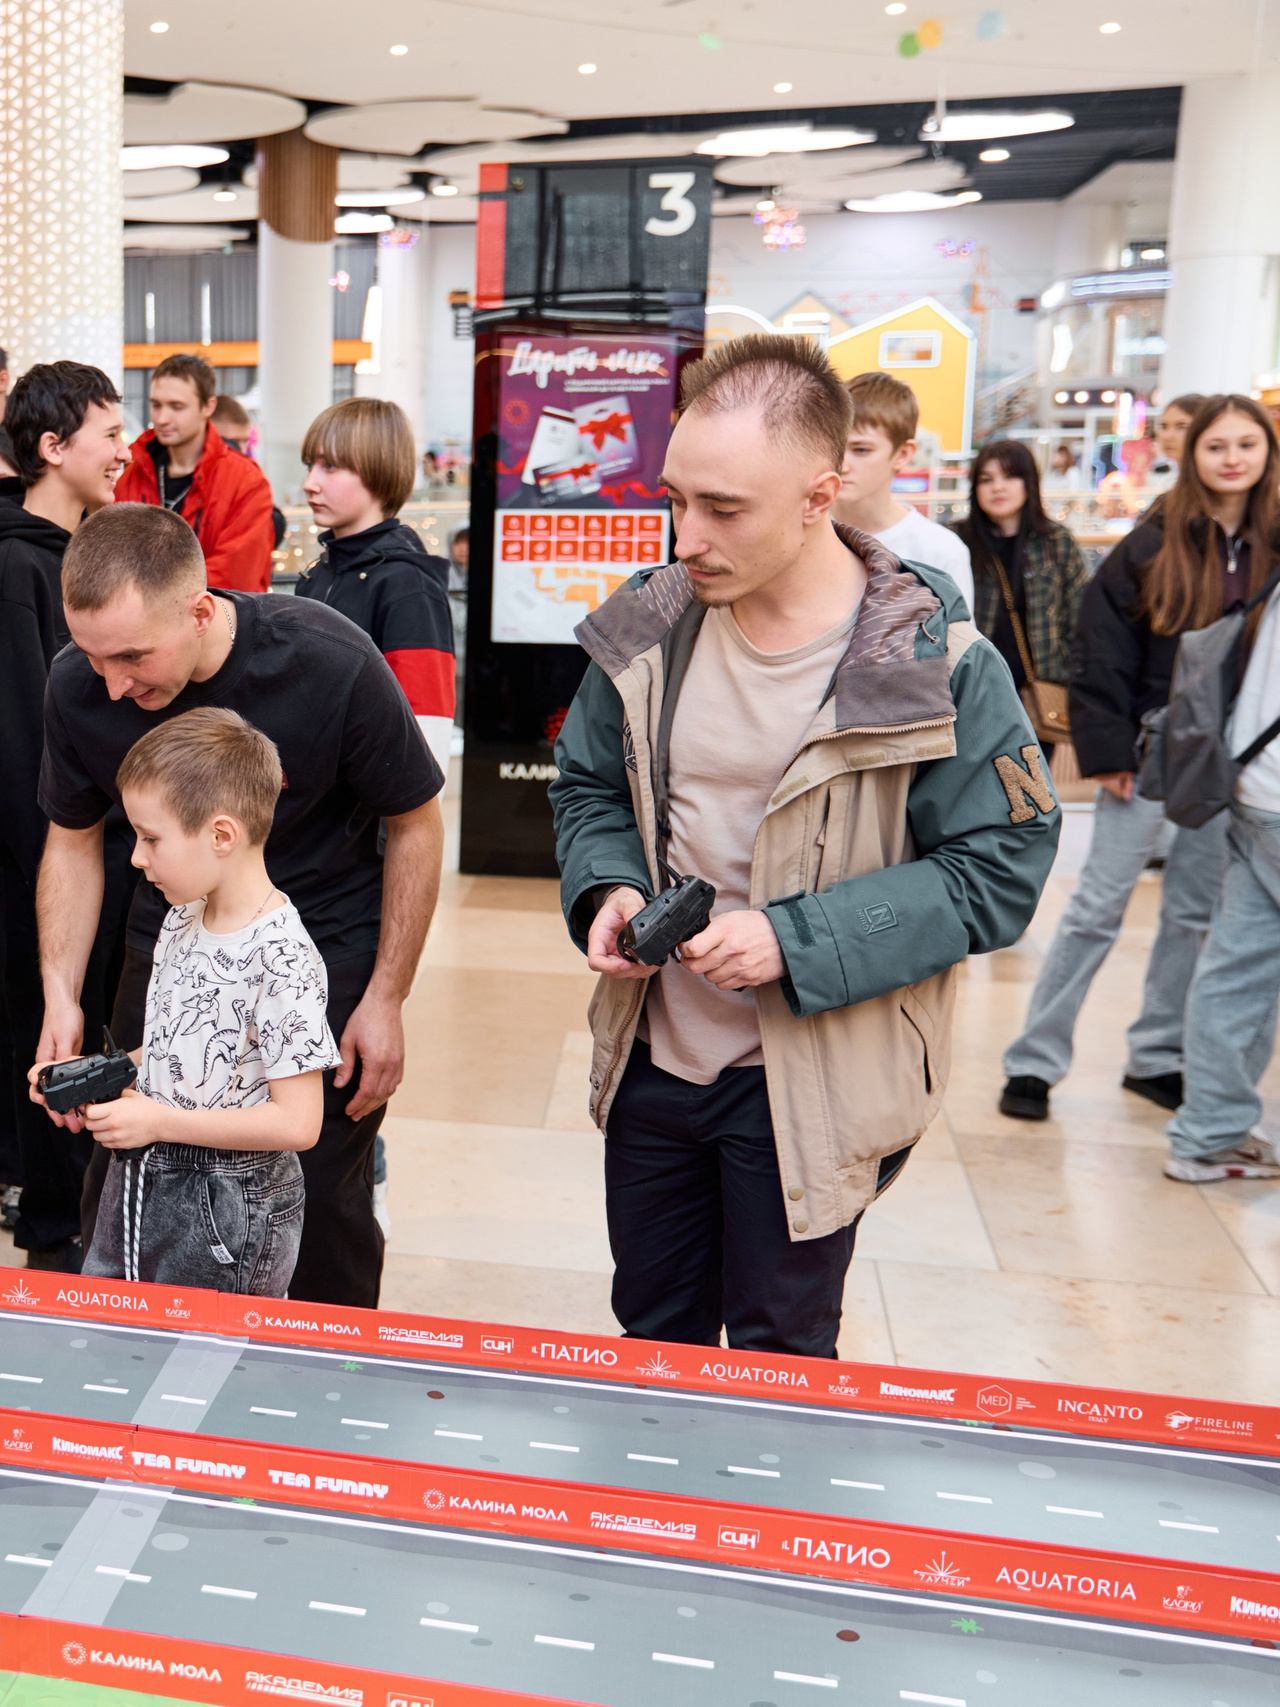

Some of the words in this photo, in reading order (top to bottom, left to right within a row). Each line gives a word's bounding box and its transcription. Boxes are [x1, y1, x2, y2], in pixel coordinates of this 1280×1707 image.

[644, 172, 697, 237] 3
[992, 744, 1057, 825] N
[56, 1289, 149, 1312] AQUATORIA
[265, 1316, 319, 1331] КАЛИНА
[379, 1326, 463, 1343] АКАДЕМИЯ
[540, 1343, 618, 1366] ПАТИО
[700, 1362, 809, 1388] AQUATORIA
[880, 1382, 955, 1402] КИНОМАКС
[980, 1394, 1008, 1407] MED
[1057, 1399, 1143, 1421] INCANTO
[1194, 1417, 1254, 1431] FIRELINE
[52, 1437, 123, 1460] КИНОМАКС
[132, 1451, 170, 1469] TEA
[175, 1457, 246, 1479] FUNNY
[269, 1469, 310, 1488] TEA
[315, 1475, 388, 1499] FUNNY
[450, 1496, 515, 1515] КАЛИНА
[591, 1512, 696, 1534] АКАДЕМИЯ
[793, 1537, 890, 1568] ПАТИО
[995, 1566, 1137, 1600] AQUATORIA
[1230, 1596, 1280, 1619] КИНО
[91, 1651, 165, 1674] КАЛИНА
[246, 1670, 363, 1700] АКАДЕМИЯ
